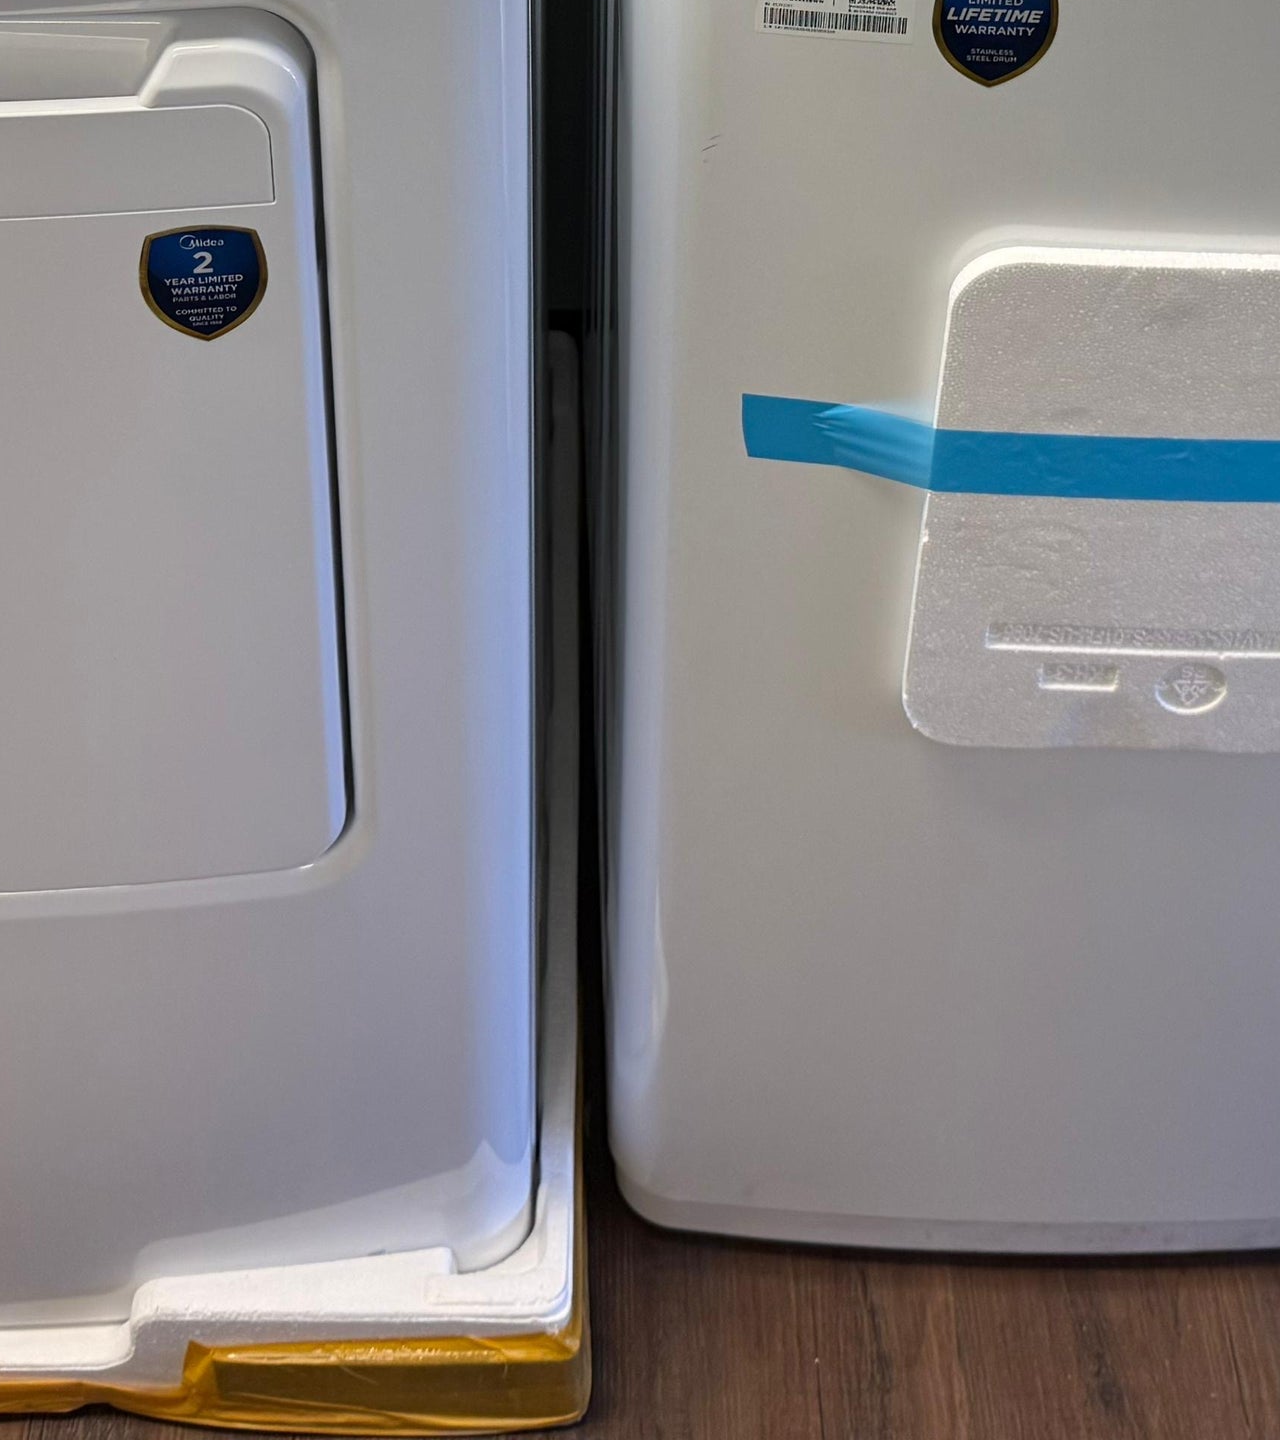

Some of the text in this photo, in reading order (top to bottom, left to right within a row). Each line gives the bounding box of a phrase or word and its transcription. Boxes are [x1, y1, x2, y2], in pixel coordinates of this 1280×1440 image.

[946, 7, 1044, 24] LIFETIME
[955, 24, 1035, 36] WARRANTY
[970, 48, 1014, 56] STAINLESS
[992, 55, 1017, 63] DRUM
[179, 234, 224, 250] Midea
[193, 251, 214, 274] 2
[164, 274, 244, 287] YEAR LIMITED
[171, 284, 238, 296] WARRANTY
[172, 293, 237, 303] PARTS LABOR
[175, 307, 224, 316] COMMITTED
[189, 314, 225, 322] QUALITY
